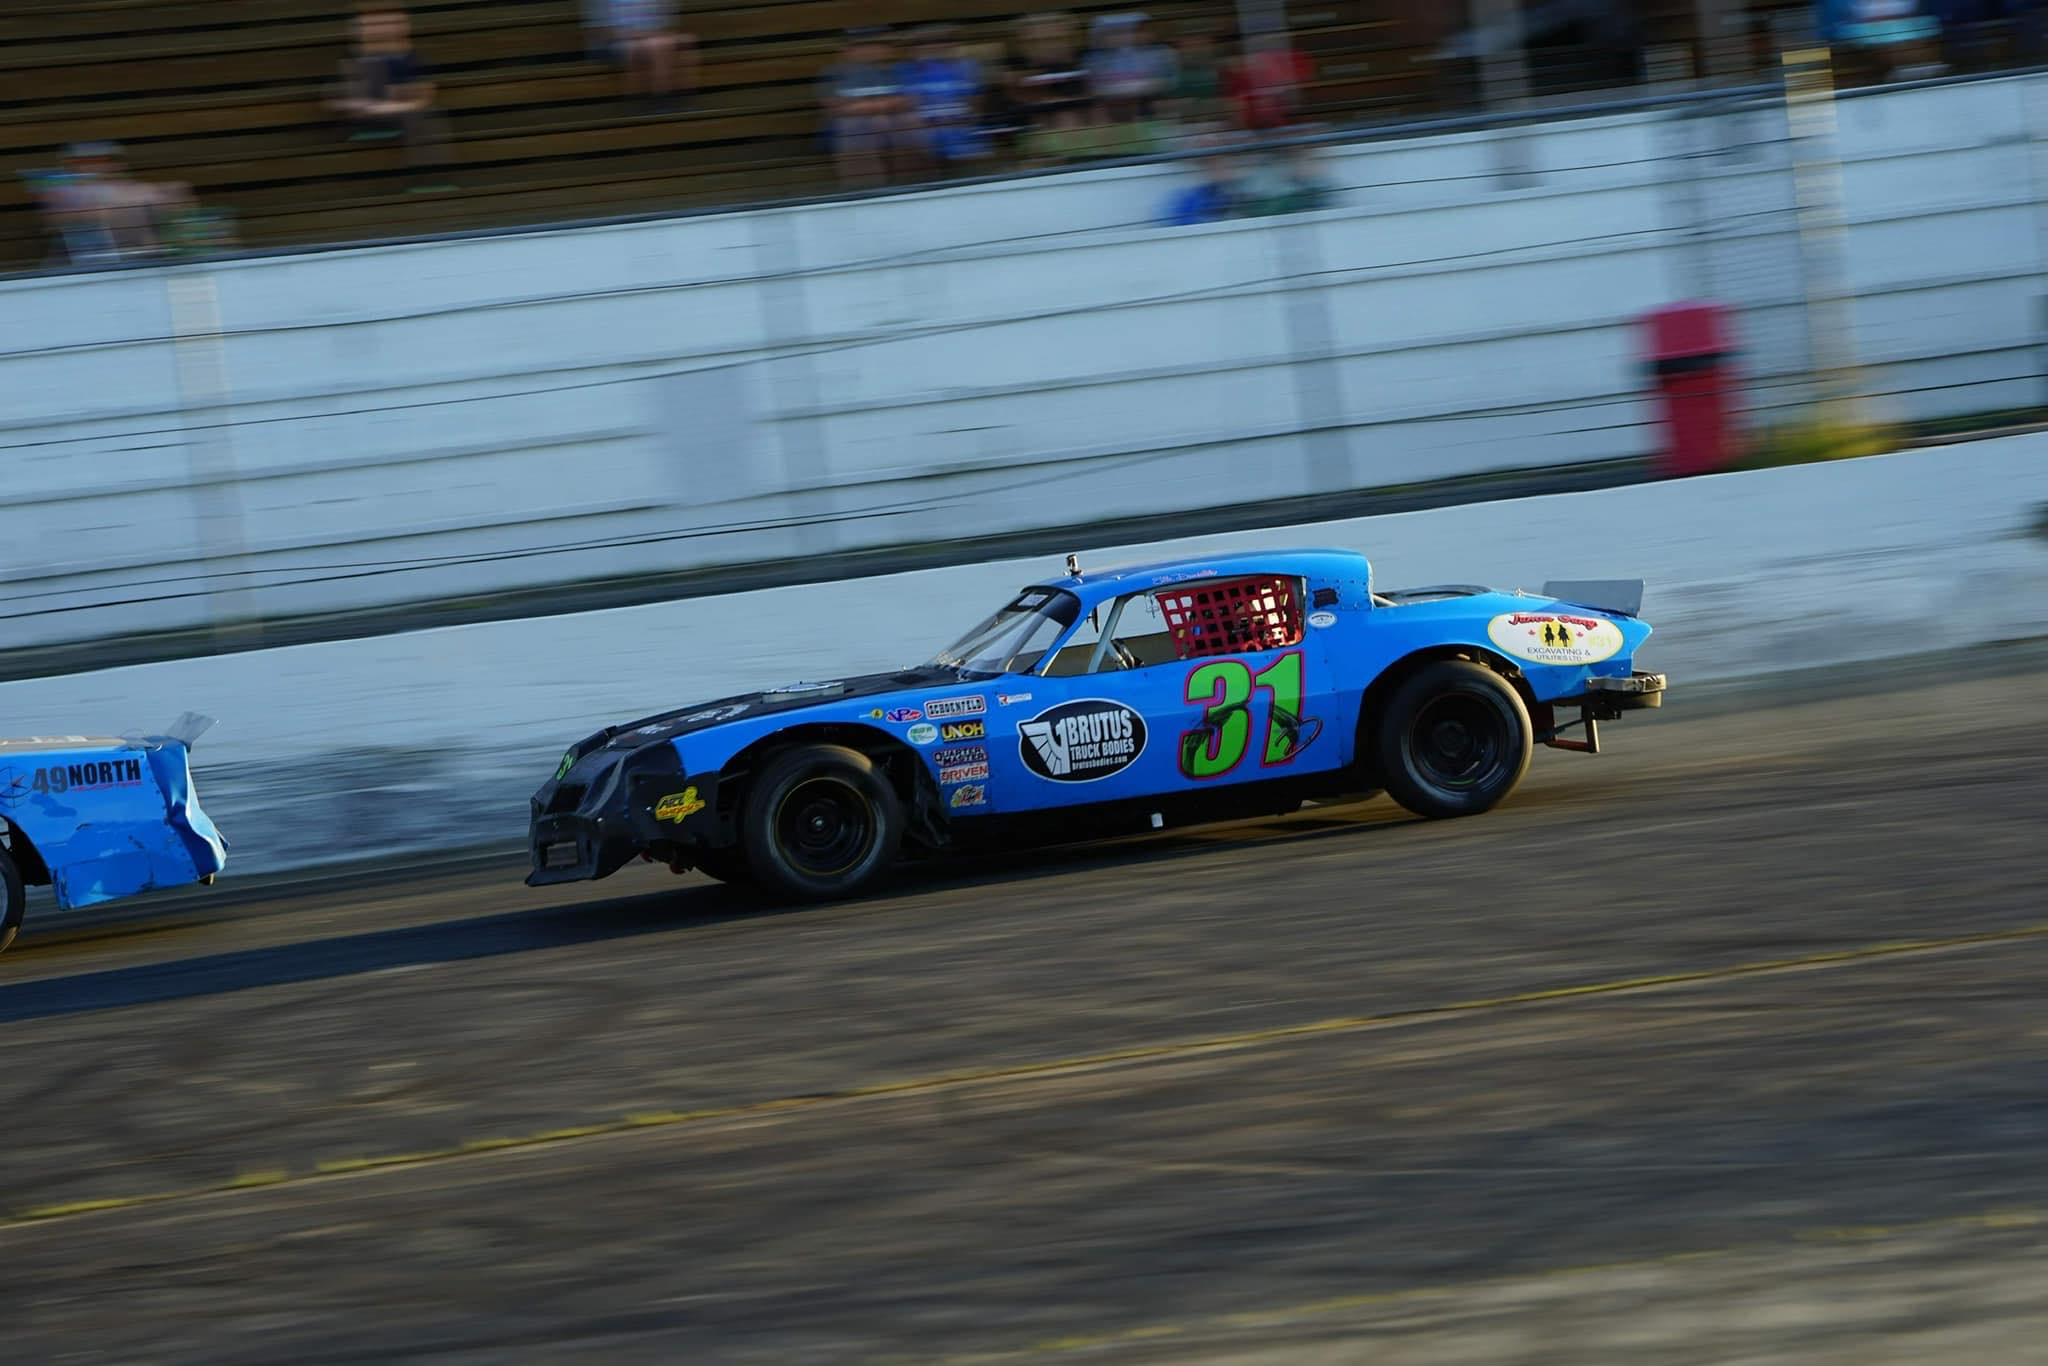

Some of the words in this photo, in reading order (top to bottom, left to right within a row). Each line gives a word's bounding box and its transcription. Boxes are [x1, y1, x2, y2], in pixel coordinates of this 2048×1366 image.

[1527, 647, 1582, 656] EXCAVATING
[928, 699, 982, 716] SCHOENFELD
[1178, 650, 1304, 781] 31
[942, 722, 984, 739] UNOH
[1066, 709, 1133, 746] BRUTUS
[1070, 744, 1101, 761] TRUCK
[1101, 738, 1135, 756] BODIES
[941, 766, 987, 781] DRIVEN
